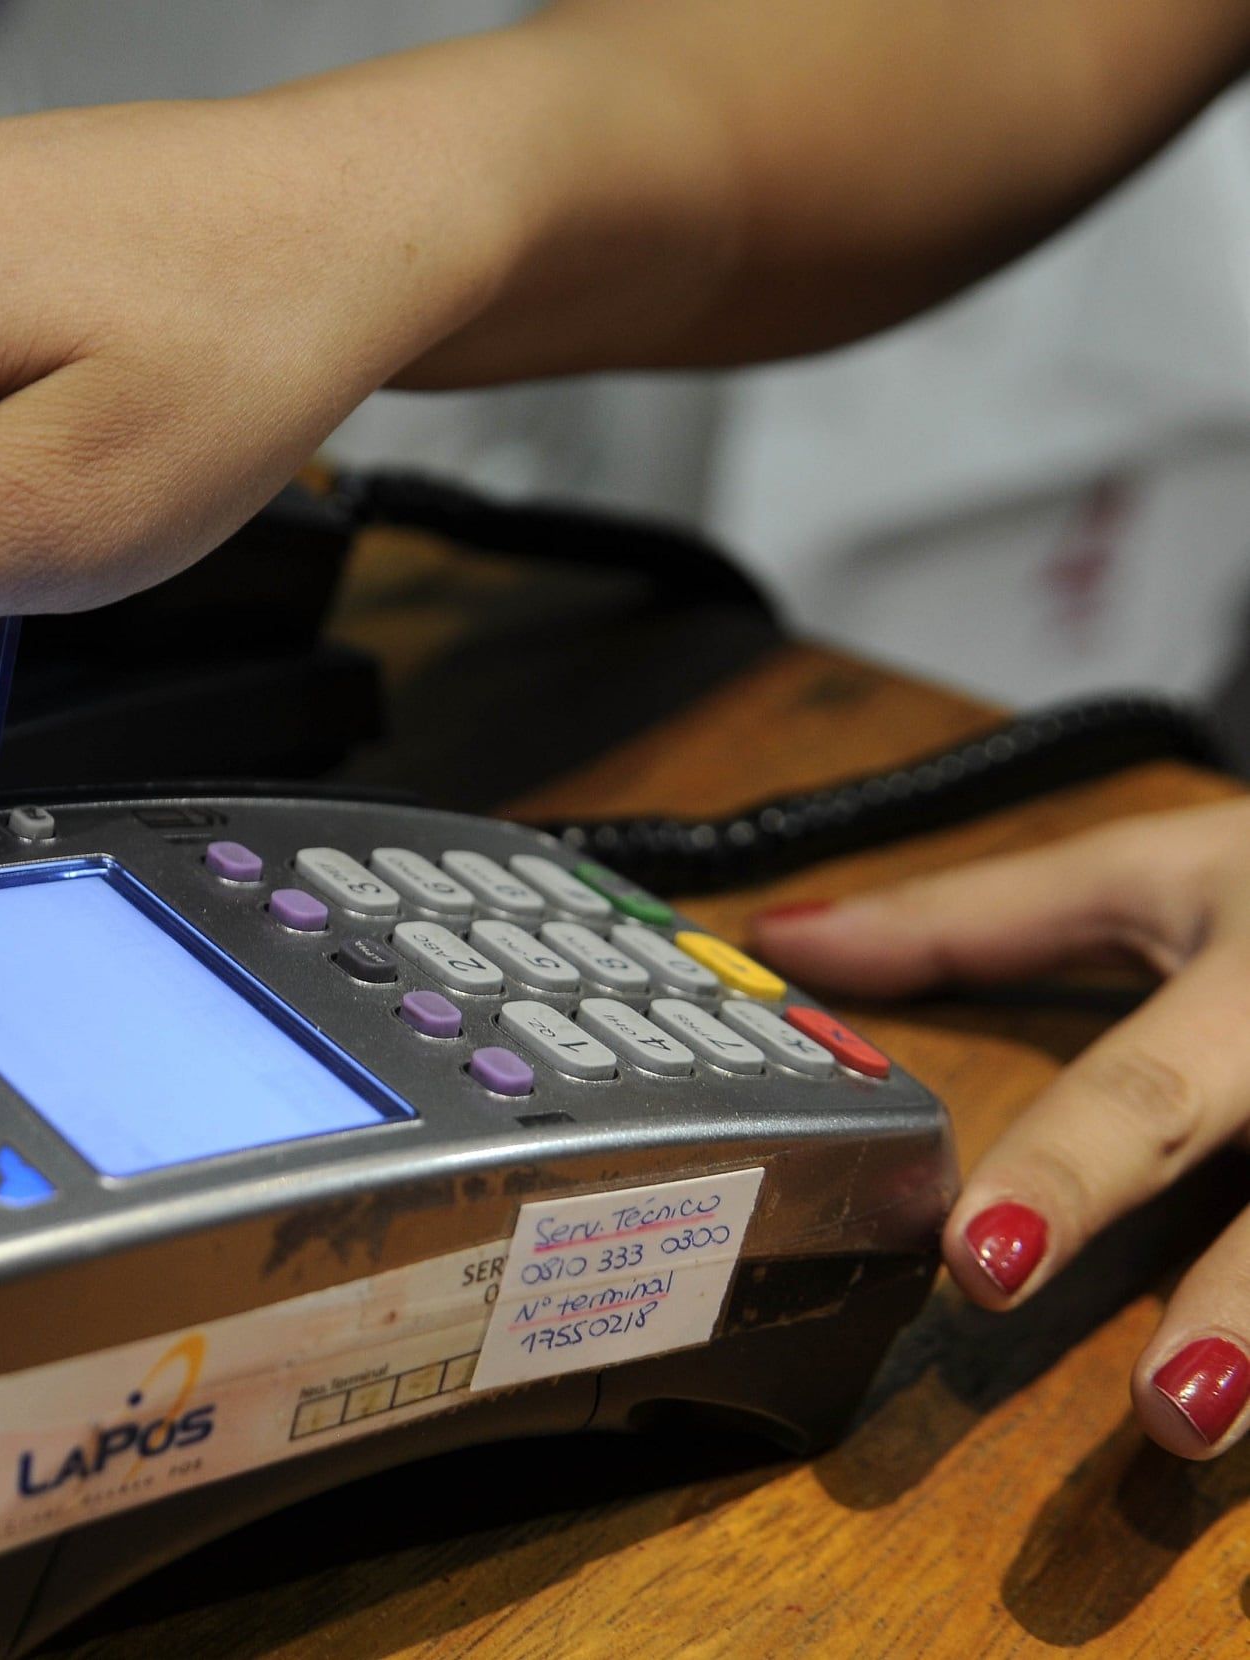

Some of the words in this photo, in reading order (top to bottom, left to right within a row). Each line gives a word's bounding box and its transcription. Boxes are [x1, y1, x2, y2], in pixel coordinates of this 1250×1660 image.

[448, 958, 487, 972] 2
[524, 957, 561, 969] 5
[637, 1037, 672, 1053] 4
[535, 1217, 603, 1248] Serv.
[521, 1255, 587, 1285] 0810
[597, 1243, 643, 1273] 333
[660, 1224, 730, 1255] 0300
[461, 1255, 510, 1287] SER
[557, 1269, 673, 1316] terminal
[520, 1301, 659, 1354] 17550218
